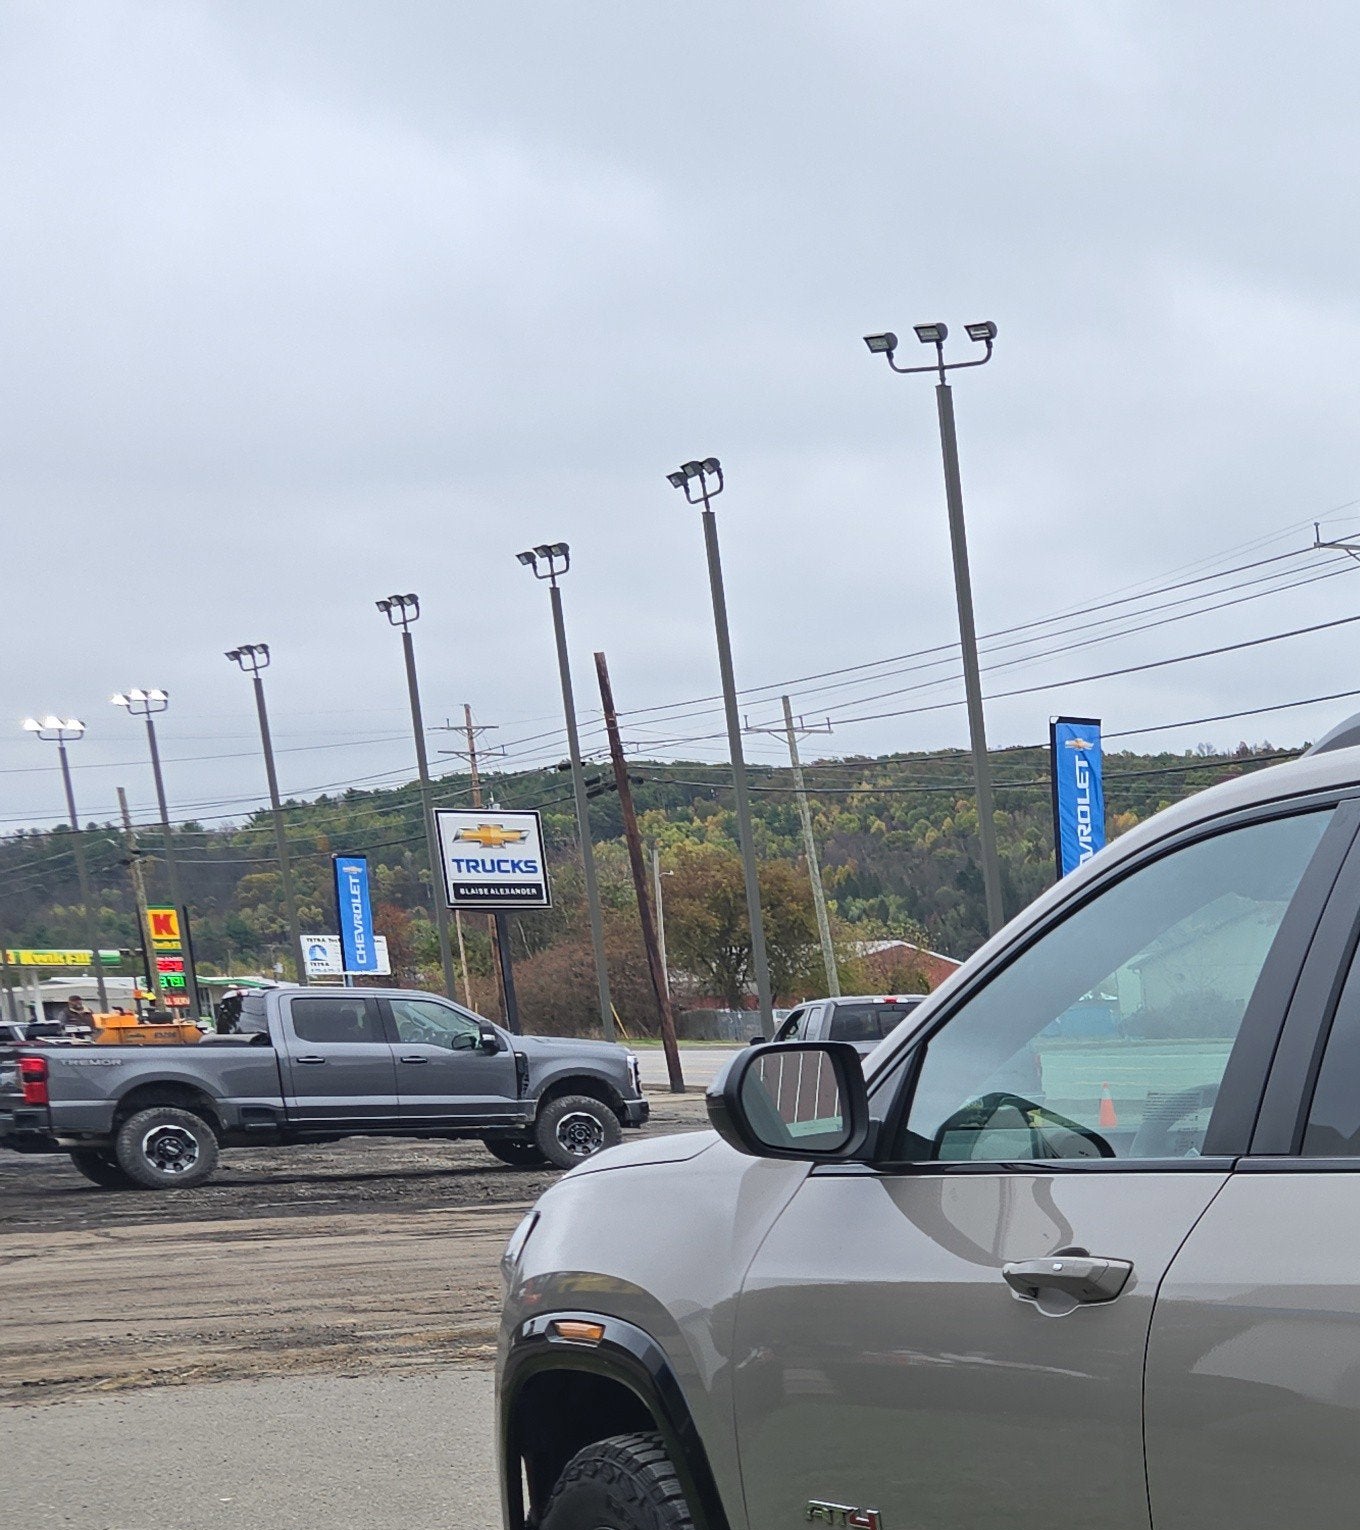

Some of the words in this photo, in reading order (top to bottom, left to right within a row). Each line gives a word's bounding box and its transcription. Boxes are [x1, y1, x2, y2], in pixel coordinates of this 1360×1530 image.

[1075, 755, 1094, 866] VROLET
[451, 858, 538, 874] TRUCKS
[459, 887, 490, 895] BLAISE
[490, 887, 537, 896] ALEXANDER
[152, 913, 177, 936] K
[348, 875, 367, 965] CHEVROLET
[60, 1058, 123, 1066] TREMOR
